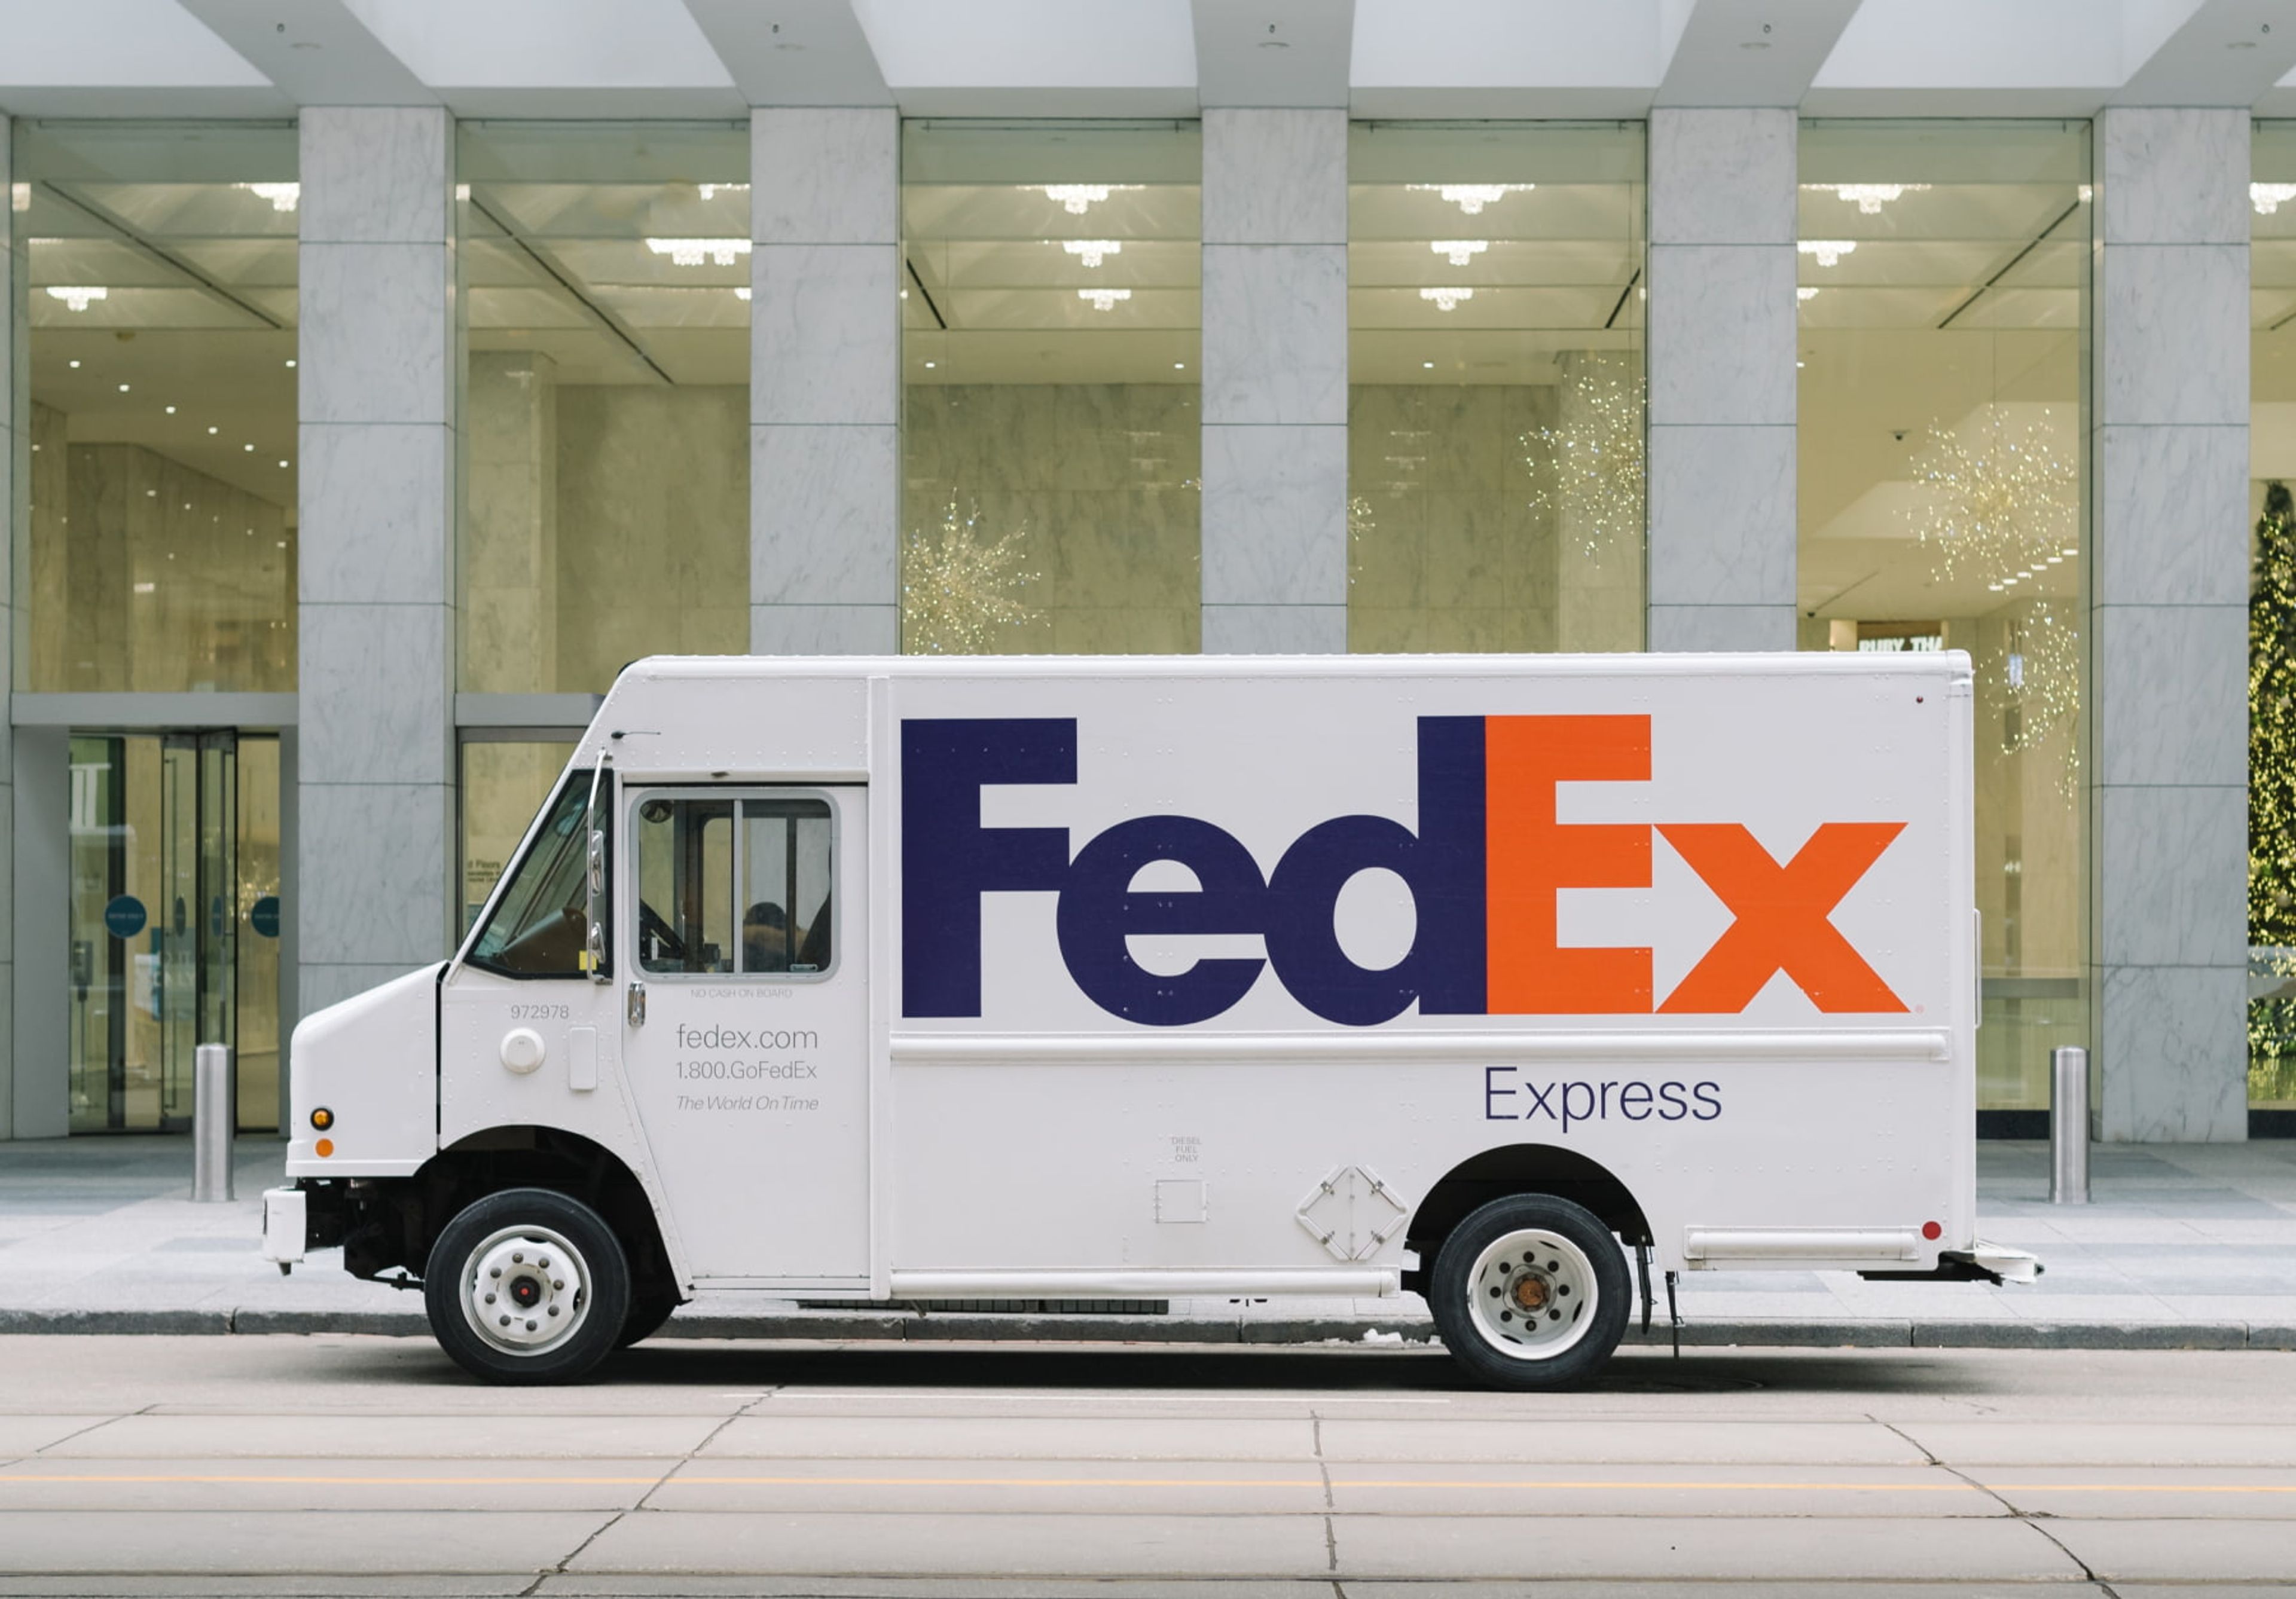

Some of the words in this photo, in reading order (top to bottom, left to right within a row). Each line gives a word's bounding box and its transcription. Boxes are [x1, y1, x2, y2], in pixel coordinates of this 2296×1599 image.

[901, 714, 1909, 1026] FedEx
[691, 989, 707, 998] NO
[709, 989, 736, 998] CASH
[738, 989, 755, 998] ON
[756, 989, 793, 998] BOARD
[511, 1005, 569, 1019] 972978
[676, 1023, 818, 1050] fedex.com
[677, 1060, 817, 1080] 1.800.GoFedEx
[677, 1096, 704, 1110] The
[707, 1096, 753, 1110] World
[756, 1096, 779, 1110] On
[782, 1096, 819, 1110] Time
[1485, 1066, 1722, 1134] Express
[1175, 1154, 1199, 1162] ONLY
